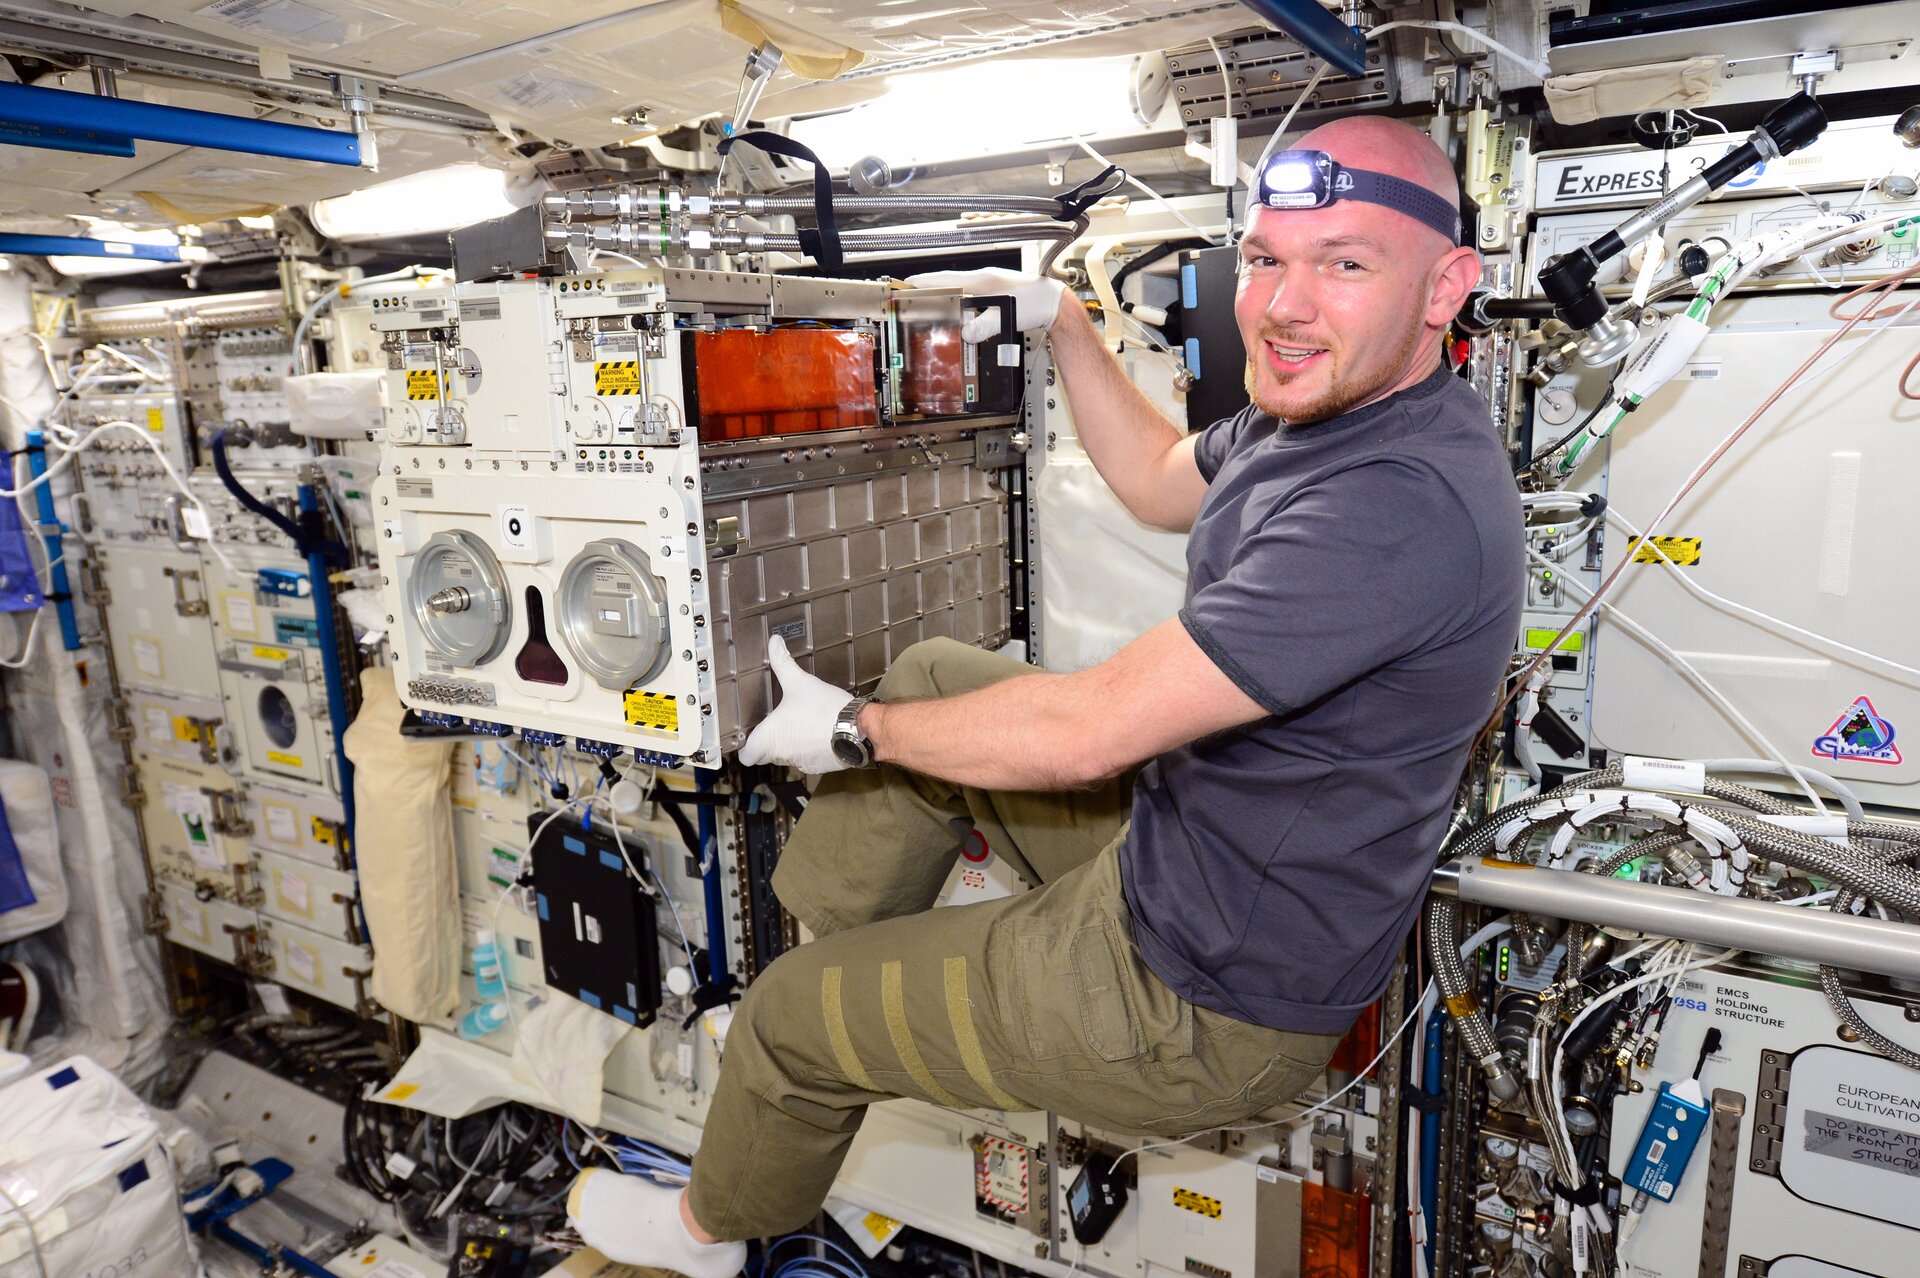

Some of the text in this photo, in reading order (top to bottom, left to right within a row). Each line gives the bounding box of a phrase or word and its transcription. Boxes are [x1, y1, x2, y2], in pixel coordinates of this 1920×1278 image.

[1557, 165, 1669, 195] EXPRESS
[1690, 157, 1706, 178] 3
[1892, 260, 1905, 268] D1
[1717, 986, 1750, 1000] EMCS
[1674, 996, 1707, 1012] esa
[1716, 998, 1768, 1014] HOLDING
[1715, 1008, 1785, 1028] STRUCTURE
[1838, 1084, 1920, 1110] EUROPEAN
[1836, 1097, 1920, 1122] CULTIVATIO
[1814, 1126, 1920, 1158] THE FRONT O
[1826, 1118, 1920, 1146] DO NOT ATT
[1850, 1149, 1920, 1170] STRUCTU
